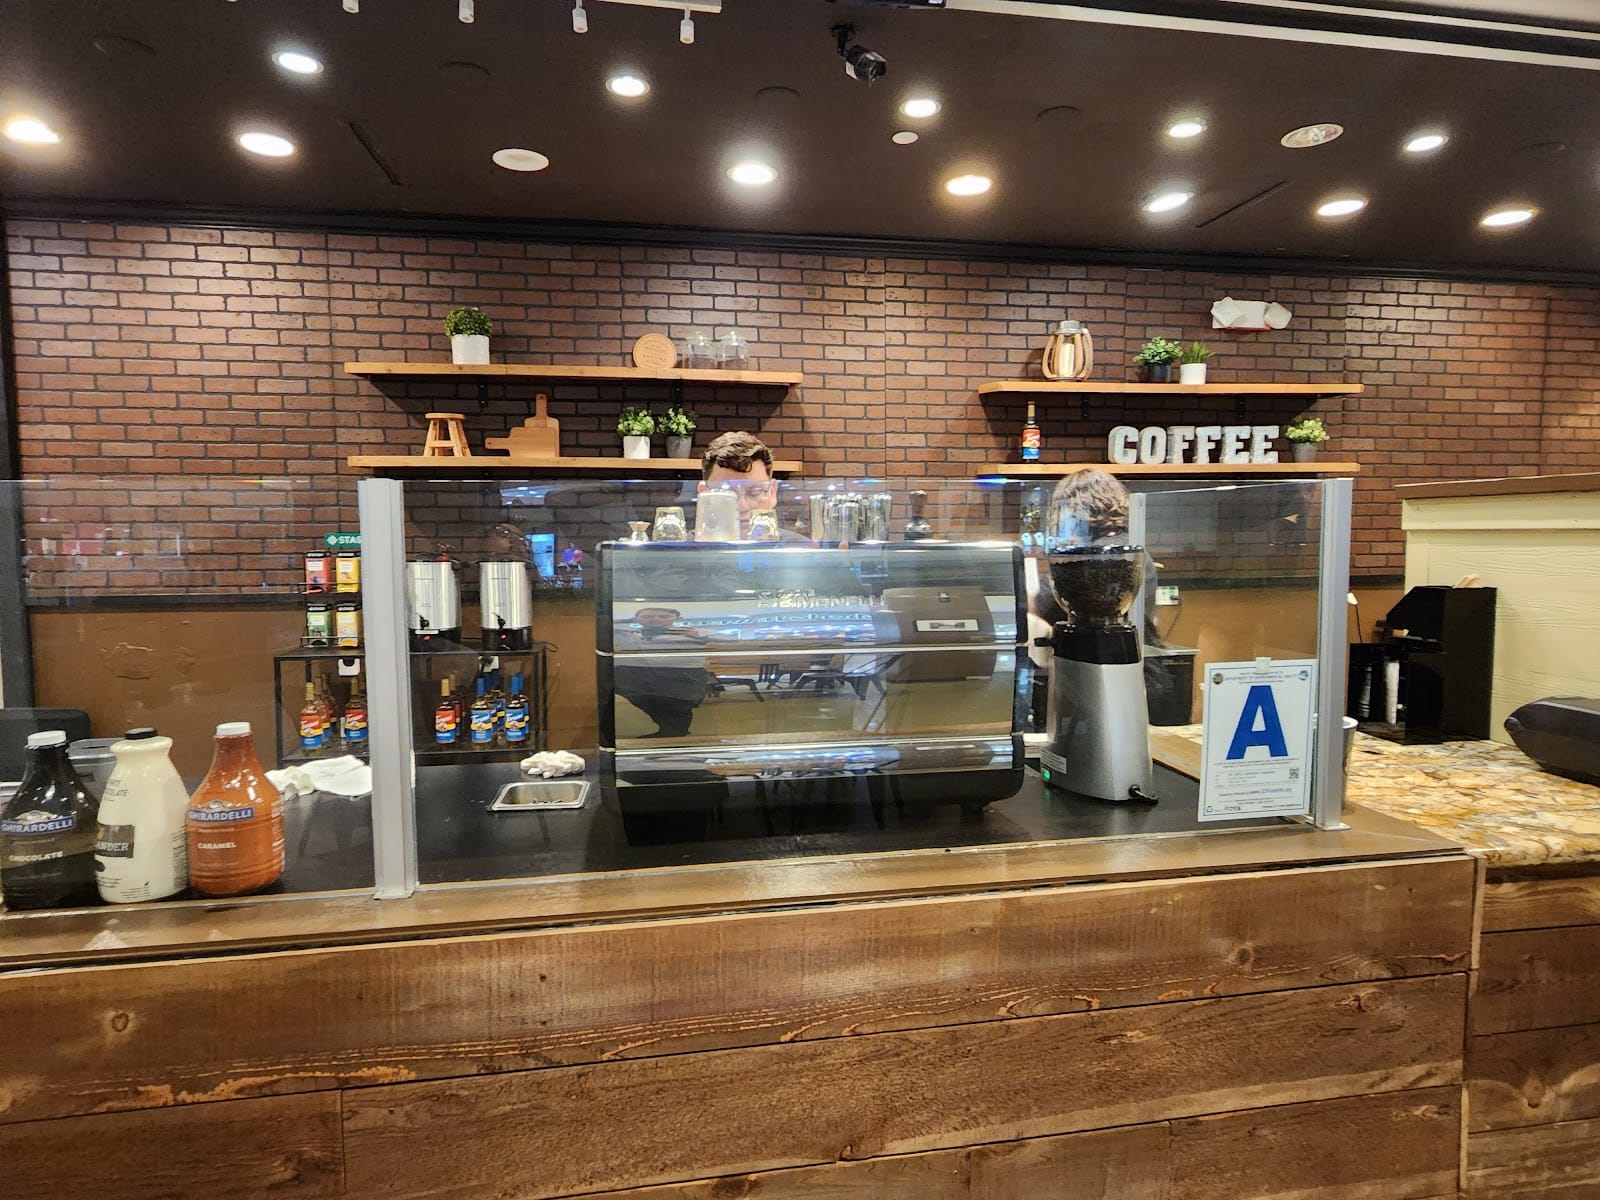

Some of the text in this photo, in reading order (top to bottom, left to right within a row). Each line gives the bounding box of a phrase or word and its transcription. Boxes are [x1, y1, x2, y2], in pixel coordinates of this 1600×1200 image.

[1108, 425, 1279, 464] COFFEE
[338, 535, 361, 544] STAS
[1226, 685, 1288, 760] A
[188, 808, 252, 821] GHIRARDELLI
[1, 819, 73, 833] GHIRARDELLI
